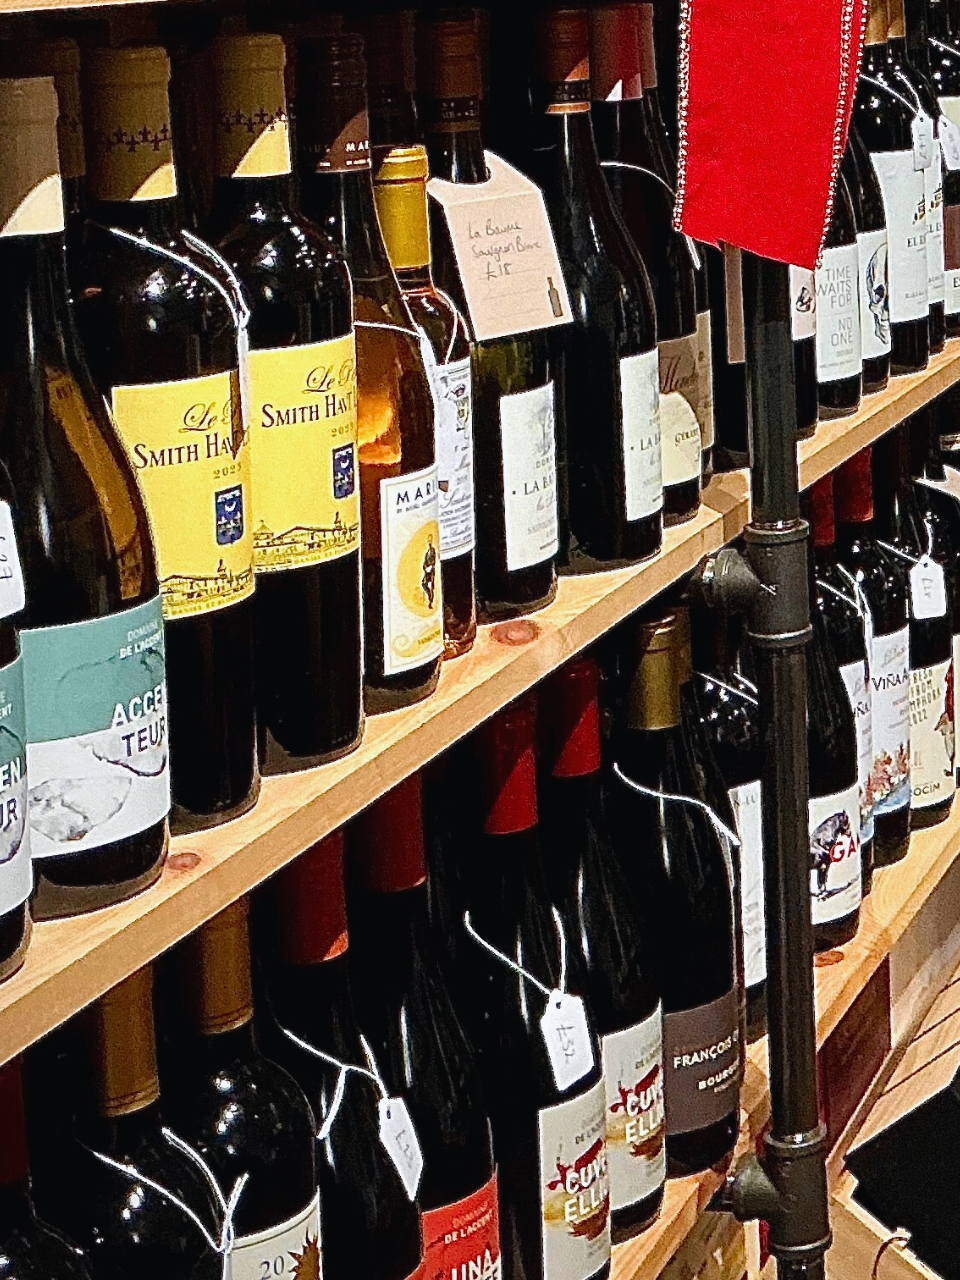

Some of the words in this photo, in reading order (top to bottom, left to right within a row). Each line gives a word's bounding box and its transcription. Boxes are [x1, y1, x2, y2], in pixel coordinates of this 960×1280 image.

[825, 265, 851, 282] TIME
[830, 293, 852, 309] FOR
[831, 333, 852, 347] ONE
[260, 403, 320, 428] SMITH
[133, 443, 199, 470] SMITH
